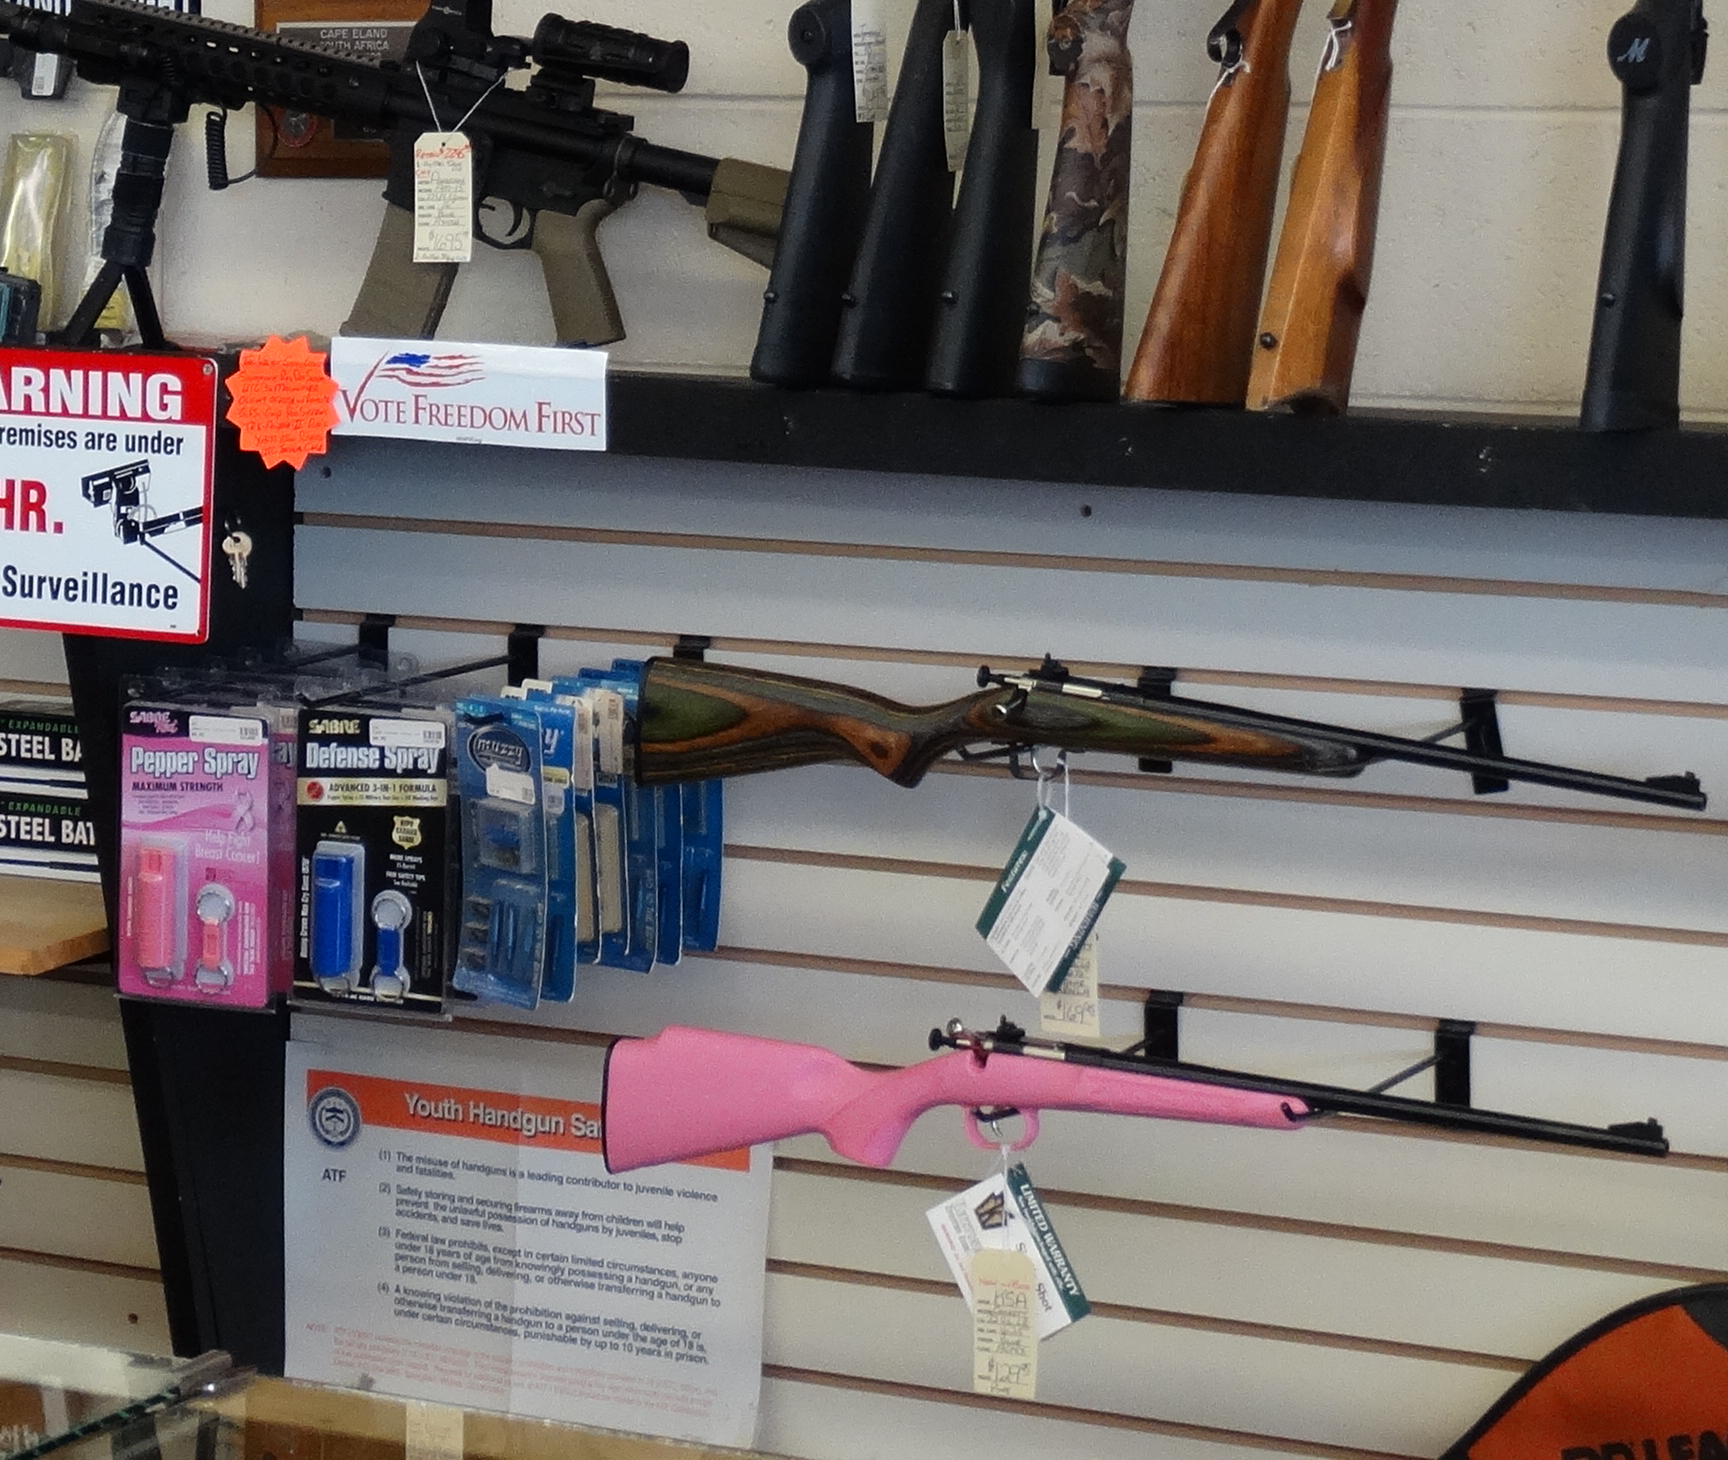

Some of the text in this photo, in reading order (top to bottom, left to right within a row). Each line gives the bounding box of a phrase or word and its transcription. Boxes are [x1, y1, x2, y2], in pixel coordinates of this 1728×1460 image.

[320, 29, 387, 40] CAPE ELAND
[320, 40, 390, 51] UTH AFRICA
[340, 378, 601, 437] VOTE FREEDOM FIRST
[84, 432, 117, 452] are
[125, 430, 184, 455] under
[1, 565, 179, 611] Surveillance
[308, 719, 361, 734] SABRE
[130, 746, 199, 778] Pepper
[204, 747, 259, 780] Spray
[306, 742, 380, 769] Defense
[384, 746, 440, 774] Spray
[477, 738, 523, 765] muzzy
[131, 781, 224, 792] MAXIMUM STRENGTH
[329, 783, 437, 793] ADVANCED 3-IN-1 FORMULA
[8, 800, 81, 817] EXPANDABLE
[61, 820, 95, 846] BAT
[403, 1093, 462, 1122] Youth
[468, 1100, 565, 1136] Handgun
[322, 1169, 347, 1183] ATF
[379, 1149, 718, 1203] (1) The misuse handguns leading contributor juvenile violence
[396, 1164, 413, 1175] and
[379, 1182, 391, 1194] (2)
[424, 1189, 455, 1204] storing
[457, 1194, 474, 1205] and
[475, 1197, 513, 1212] securing
[581, 1209, 604, 1223] from
[605, 1213, 644, 1228] children
[664, 1221, 685, 1236] help
[441, 1215, 458, 1226] and
[487, 1211, 538, 1225] possession
[551, 1217, 600, 1233] handguns
[661, 1232, 682, 1246] stop
[1020, 1183, 1048, 1231] LIMITED
[1042, 1230, 1080, 1297] WARRANTY
[378, 1226, 391, 1238] (3)
[492, 1244, 521, 1257] except
[535, 1250, 569, 1263] certain
[571, 1253, 604, 1268] limited
[681, 1271, 718, 1284] anyone
[395, 1241, 421, 1254] under
[436, 1248, 461, 1259] years
[493, 1253, 513, 1266] from
[514, 1256, 566, 1276] knowingly
[568, 1267, 624, 1284] possessing
[394, 1253, 708, 1307] person from otherwise transferring handgun
[402, 1265, 463, 1282] person under
[403, 1285, 601, 1325] knowing violation prohibition against
[1036, 1282, 1053, 1313] Shot
[393, 1296, 630, 1341] otherwise transferring handgun person under
[393, 1308, 420, 1320] under
[635, 1345, 662, 1357] years
